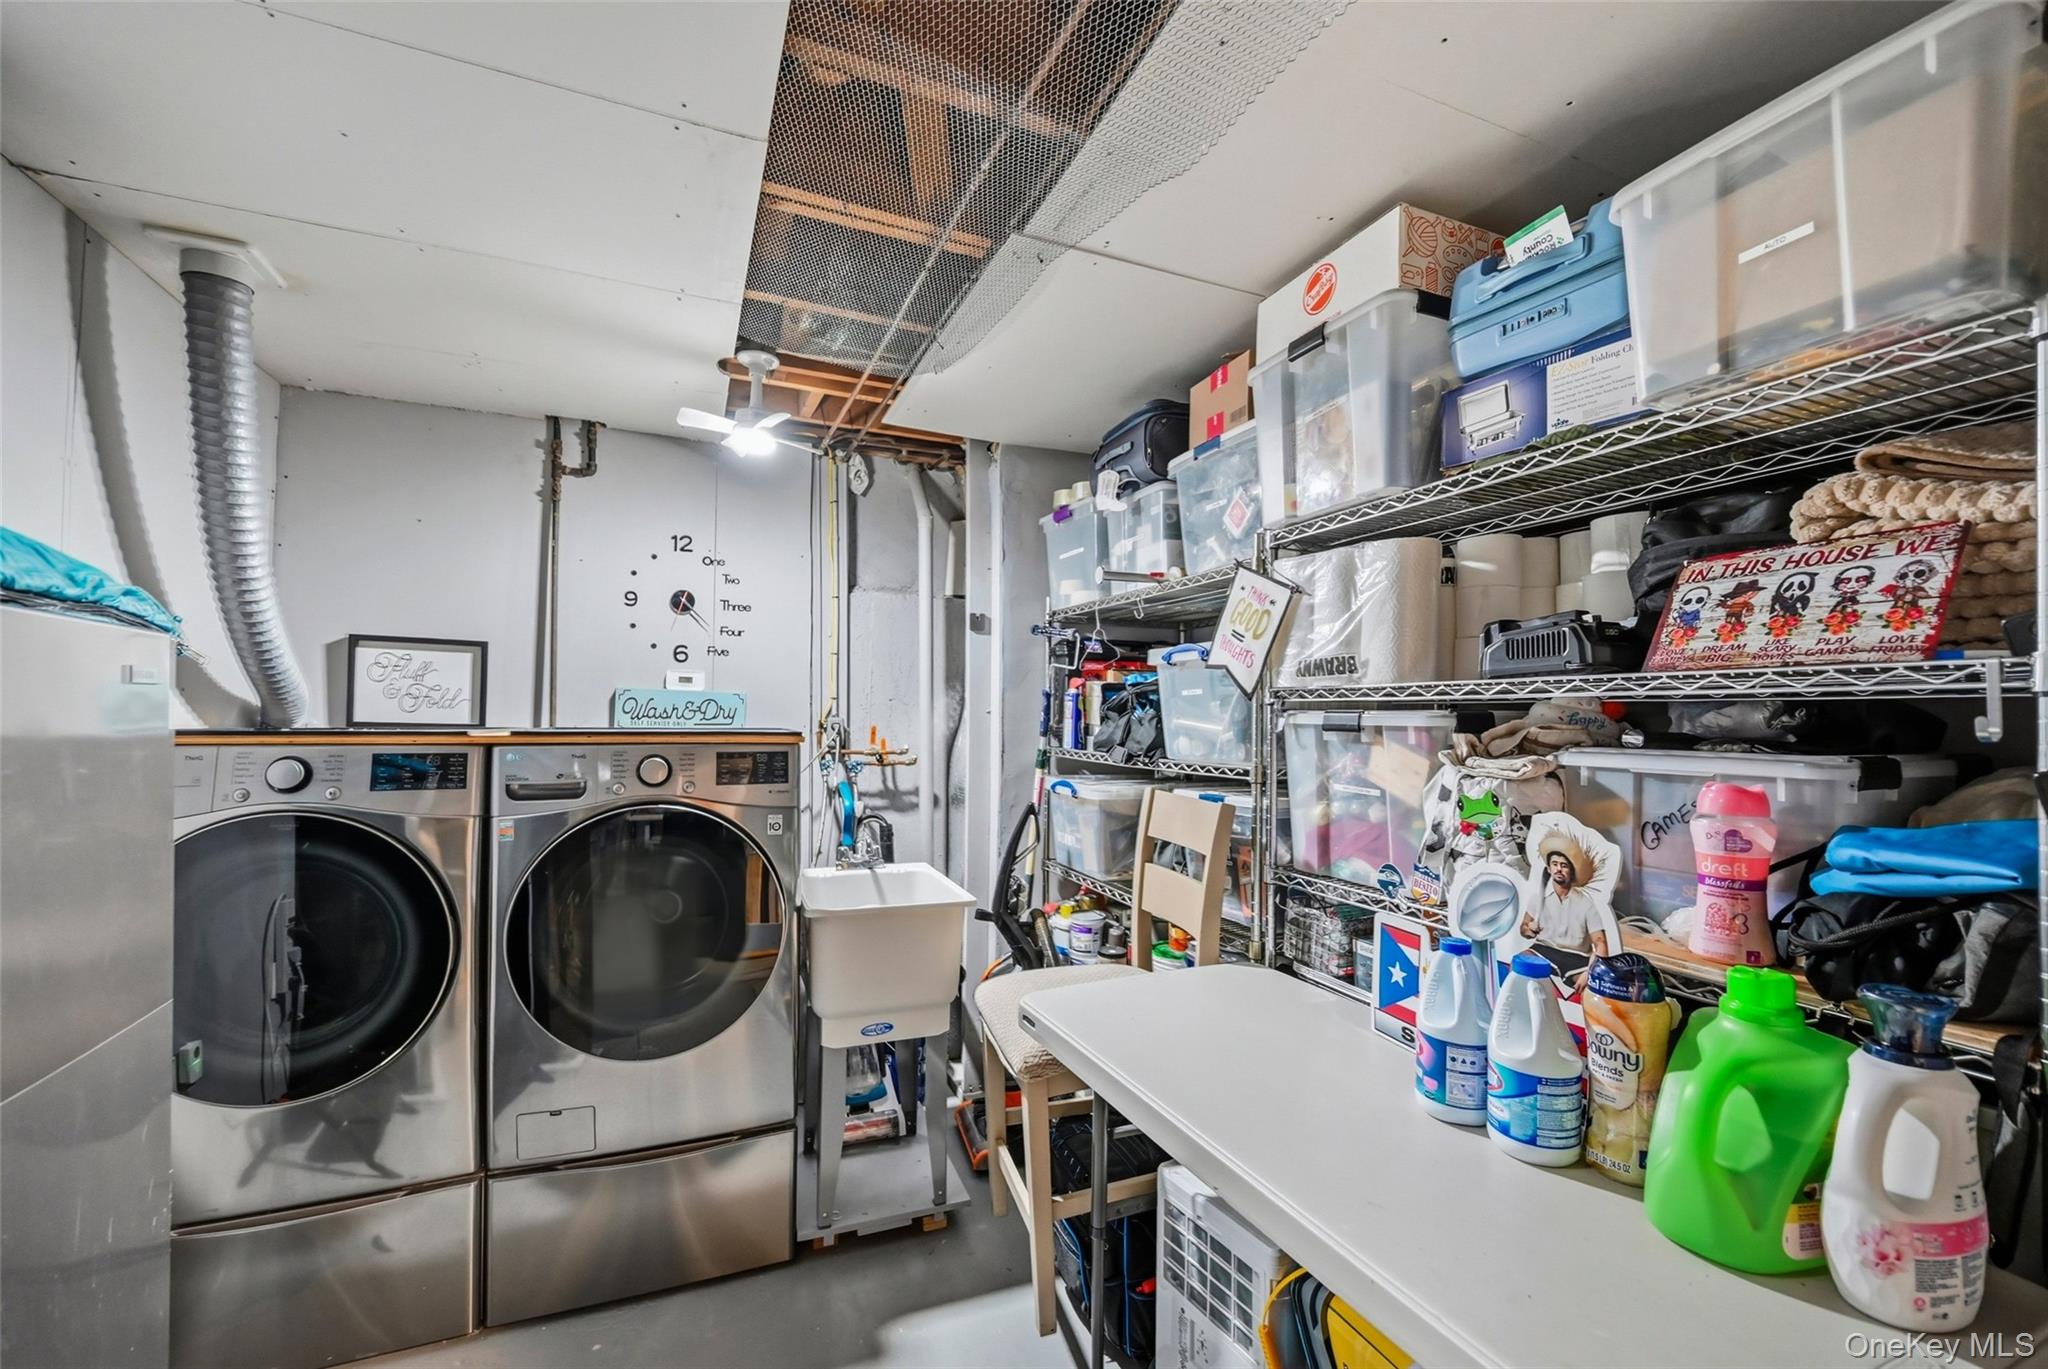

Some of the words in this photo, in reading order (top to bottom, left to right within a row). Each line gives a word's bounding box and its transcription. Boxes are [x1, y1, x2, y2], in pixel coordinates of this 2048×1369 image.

[1523, 234, 1553, 256] County
[1591, 349, 1621, 364] Folding
[671, 535, 693, 552] 12
[702, 555, 726, 567] One
[1686, 568, 1711, 583] IN
[1716, 557, 1775, 579] THIS
[1782, 542, 1882, 571] HOUSE
[1895, 535, 1945, 556] WE
[721, 573, 741, 585] Two
[624, 591, 638, 607] 9
[1247, 586, 1269, 607] THINK
[720, 599, 752, 612] Three
[1229, 597, 1271, 640] GOOD
[720, 626, 745, 637] Four
[1879, 634, 1921, 644] LOVE
[1702, 643, 1746, 653] DREAM
[1764, 637, 1791, 646] LIKE
[1815, 635, 1857, 646] PLAY
[673, 644, 689, 663] 6
[707, 646, 730, 657] Five
[1219, 634, 1256, 669] THOUGHTS
[1758, 644, 1798, 653] SCARY
[1804, 646, 1860, 657] GAMES
[1704, 653, 1731, 662] BIG
[1751, 652, 1795, 661] MOVIES
[367, 652, 439, 682] Fluff
[1295, 655, 1358, 677] BRAWNY
[383, 678, 401, 699] &
[399, 683, 472, 713] Fold
[1701, 856, 1749, 878] dreft
[1592, 1057, 1624, 1077] Blends
[1622, 1163, 1631, 1174] OZ
